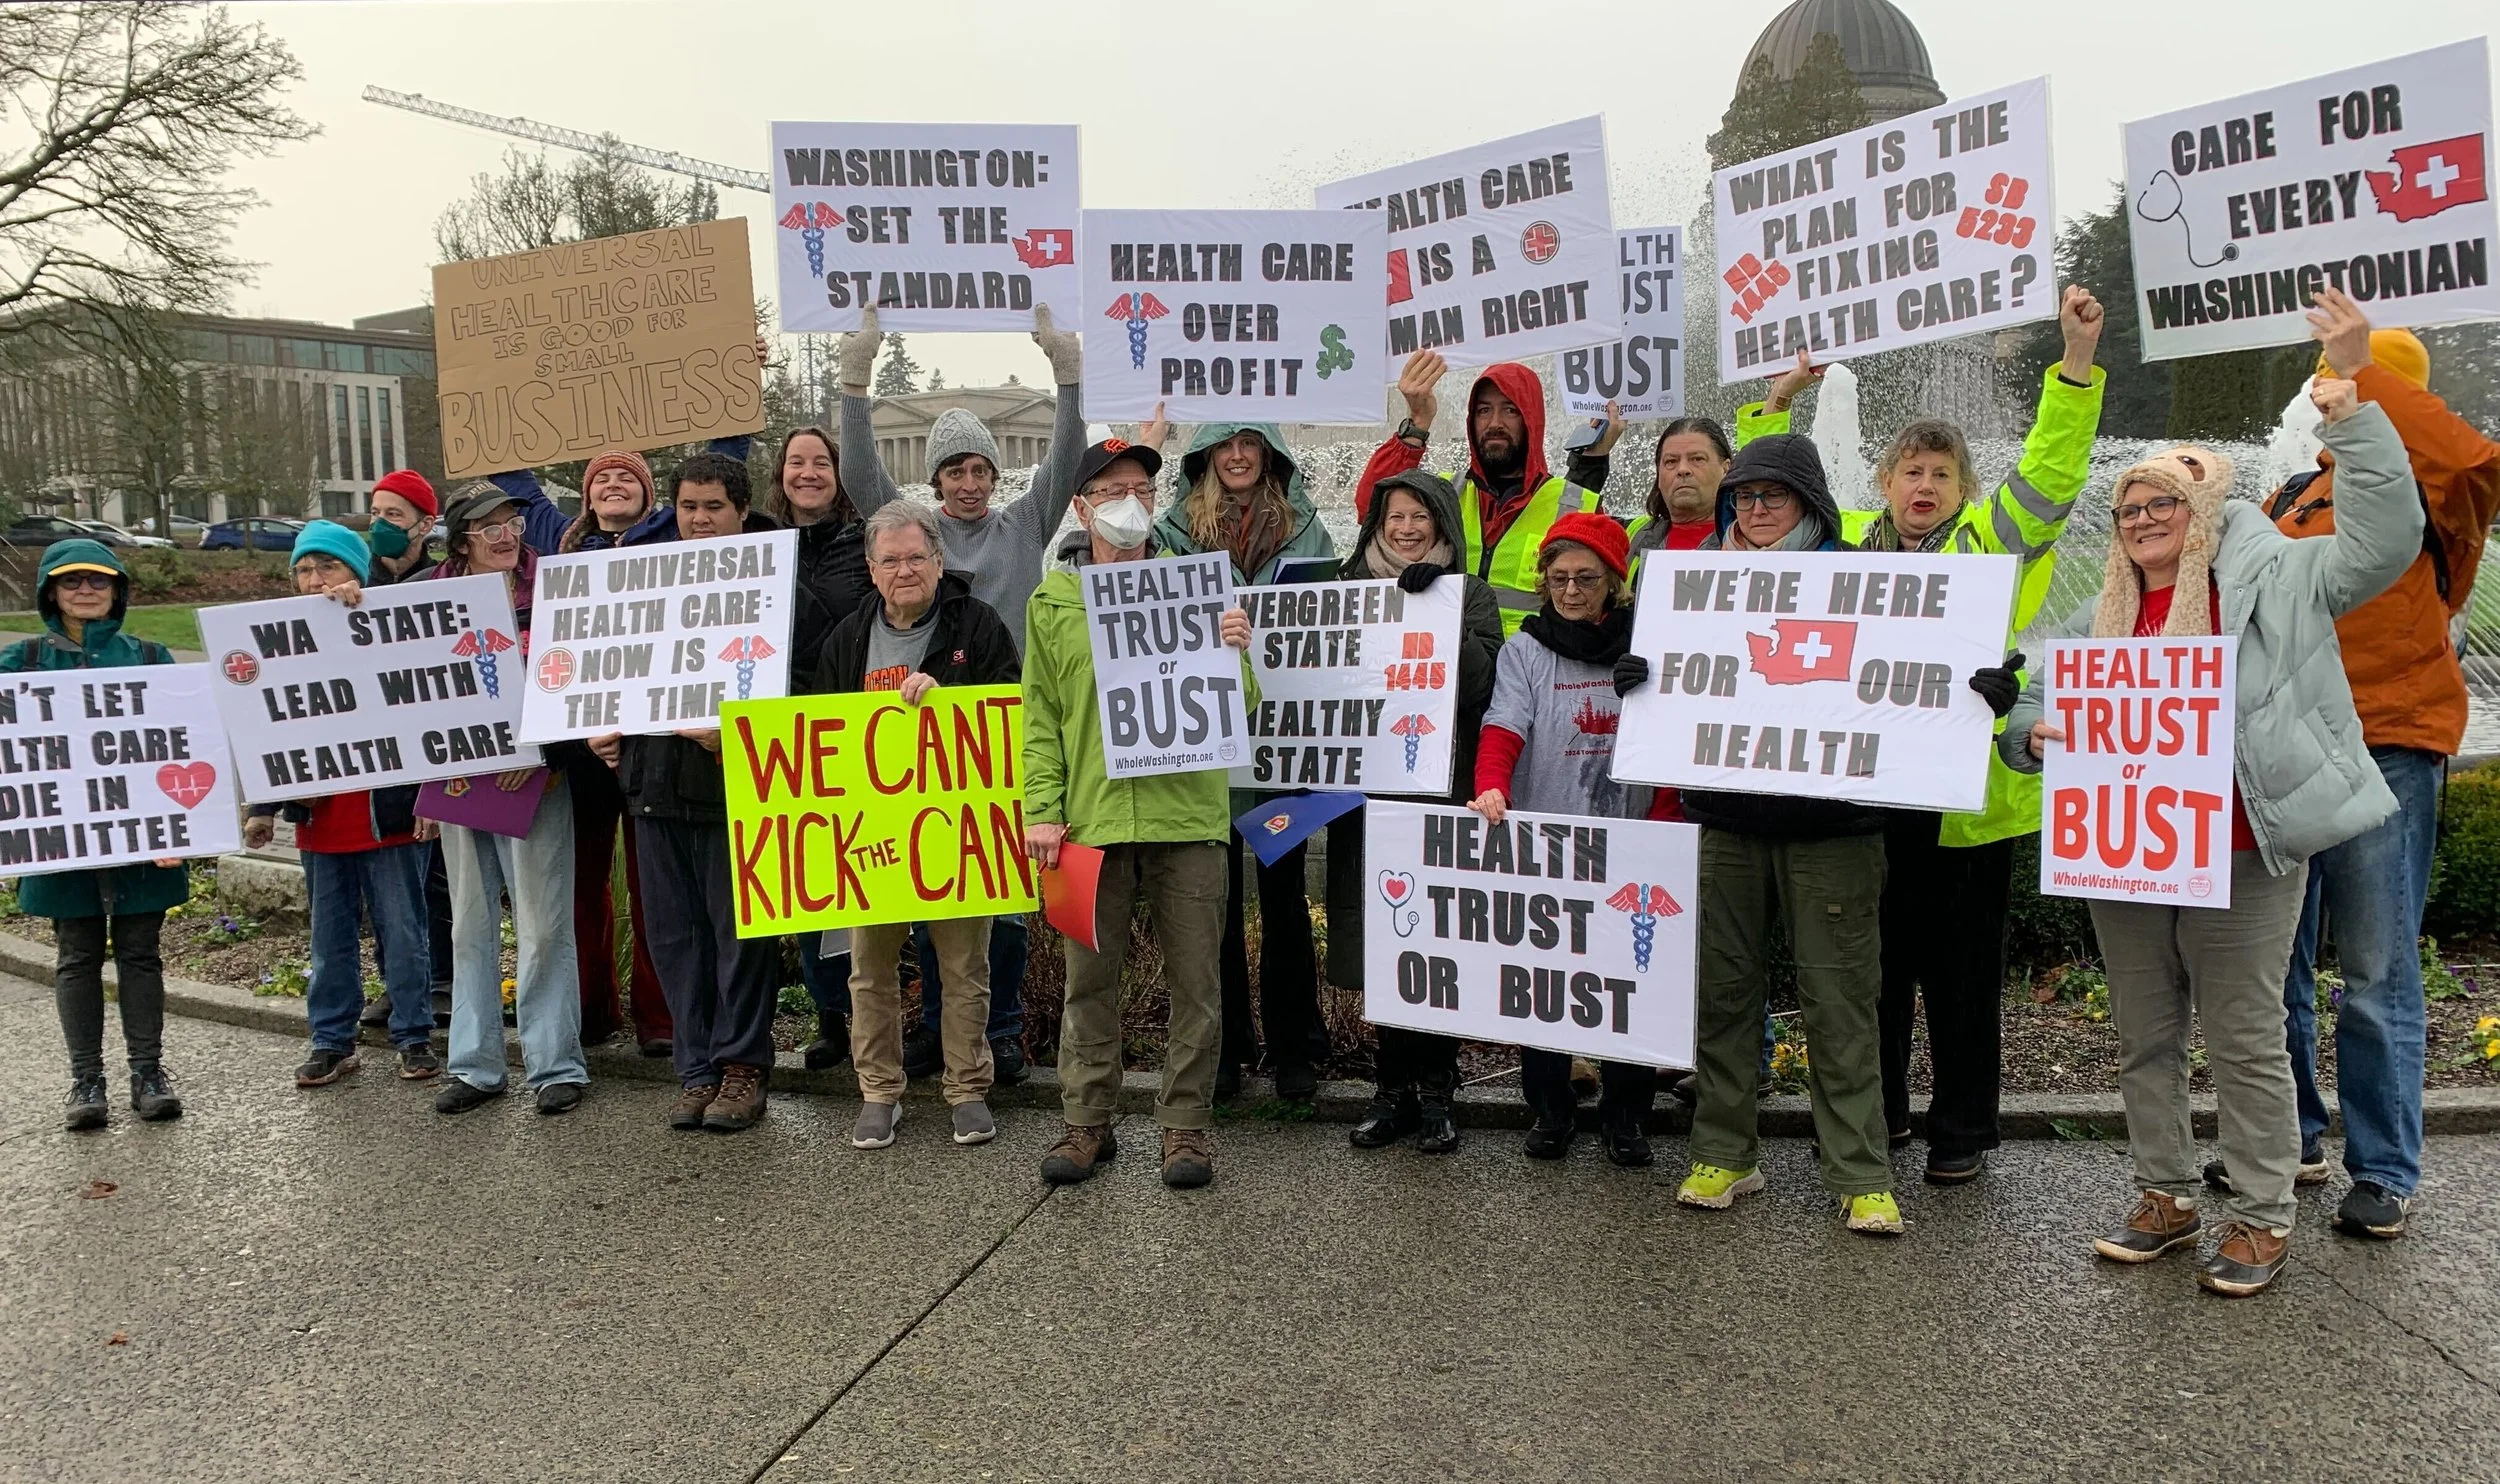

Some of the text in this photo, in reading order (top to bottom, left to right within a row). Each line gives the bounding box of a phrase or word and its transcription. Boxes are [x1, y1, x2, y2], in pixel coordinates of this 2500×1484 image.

[2171, 83, 2403, 177] CARE FOR
[784, 148, 1049, 188] WASHINGTON:
[1729, 100, 2009, 216] WHAT IS THE
[1343, 152, 1573, 234] ALTH CARE
[1762, 172, 1957, 260] PLAN FOR
[1985, 172, 2029, 210] SB
[2227, 170, 2362, 240] EVERY
[846, 205, 1008, 244] SET THE
[1621, 233, 1674, 267] LTH
[1956, 206, 2036, 249] 5233
[472, 225, 714, 290] UNIVERSAL
[1110, 242, 1353, 282] HEALTH CARE
[1416, 233, 1496, 287] IS A
[1797, 228, 1940, 302] FIXING
[2146, 237, 2488, 330] WASHINGTONIAN
[451, 265, 717, 340] HEALTHCARE
[826, 271, 1033, 310] STANDARD
[1734, 253, 2037, 369] HEALTH CARE?
[494, 308, 687, 359] IS GOOD FOR
[1183, 302, 1279, 342] OVER
[1389, 305, 1464, 356] MAN
[1482, 280, 1589, 338] RIGHT
[535, 342, 634, 377] SMALL
[1161, 356, 1303, 396] PROFIT
[1564, 335, 1678, 399] BUST
[441, 344, 762, 474] BUSINESS
[543, 543, 776, 600] WA UNIVERSAL
[1091, 561, 1223, 607] HEALTH
[1673, 567, 1950, 618] WE'RE HERE
[250, 599, 472, 659] WA STATE:
[552, 589, 772, 642] HEALTH CARE:
[1099, 601, 1224, 660] TRUST
[1234, 585, 1405, 628] VERGREEN
[580, 638, 705, 683] NOW IS
[1159, 659, 1177, 675] or
[1264, 629, 1361, 669] STATE
[2055, 647, 2222, 689] HEALTH
[0, 681, 147, 725] N'T LET
[262, 661, 478, 722] LEAD WITH
[1384, 662, 1445, 691] 1445
[1659, 652, 1952, 709] FOR OUR
[564, 681, 726, 728] THE TIME
[1107, 676, 1237, 749] BUST
[2057, 697, 2220, 756] TRUST
[0, 726, 190, 775] LTH CARE
[262, 721, 516, 788] HEALTH CARE
[735, 697, 1022, 803] WE CANT
[1115, 753, 1213, 770] WholeWashington.ORG
[1254, 746, 1363, 785] STATE
[1693, 723, 1880, 778] HEALTH
[2122, 763, 2146, 780] or
[0, 775, 129, 821] DIE IN
[0, 813, 190, 866] MMITTEE
[1423, 814, 1607, 883] HEALTH
[2053, 785, 2223, 871] BUST
[734, 800, 1035, 926] KICK THE CAN
[2053, 872, 2178, 895] WholeWashington.ORG
[1427, 885, 1594, 954] TRUST
[1397, 951, 1636, 1034] OR BUST
